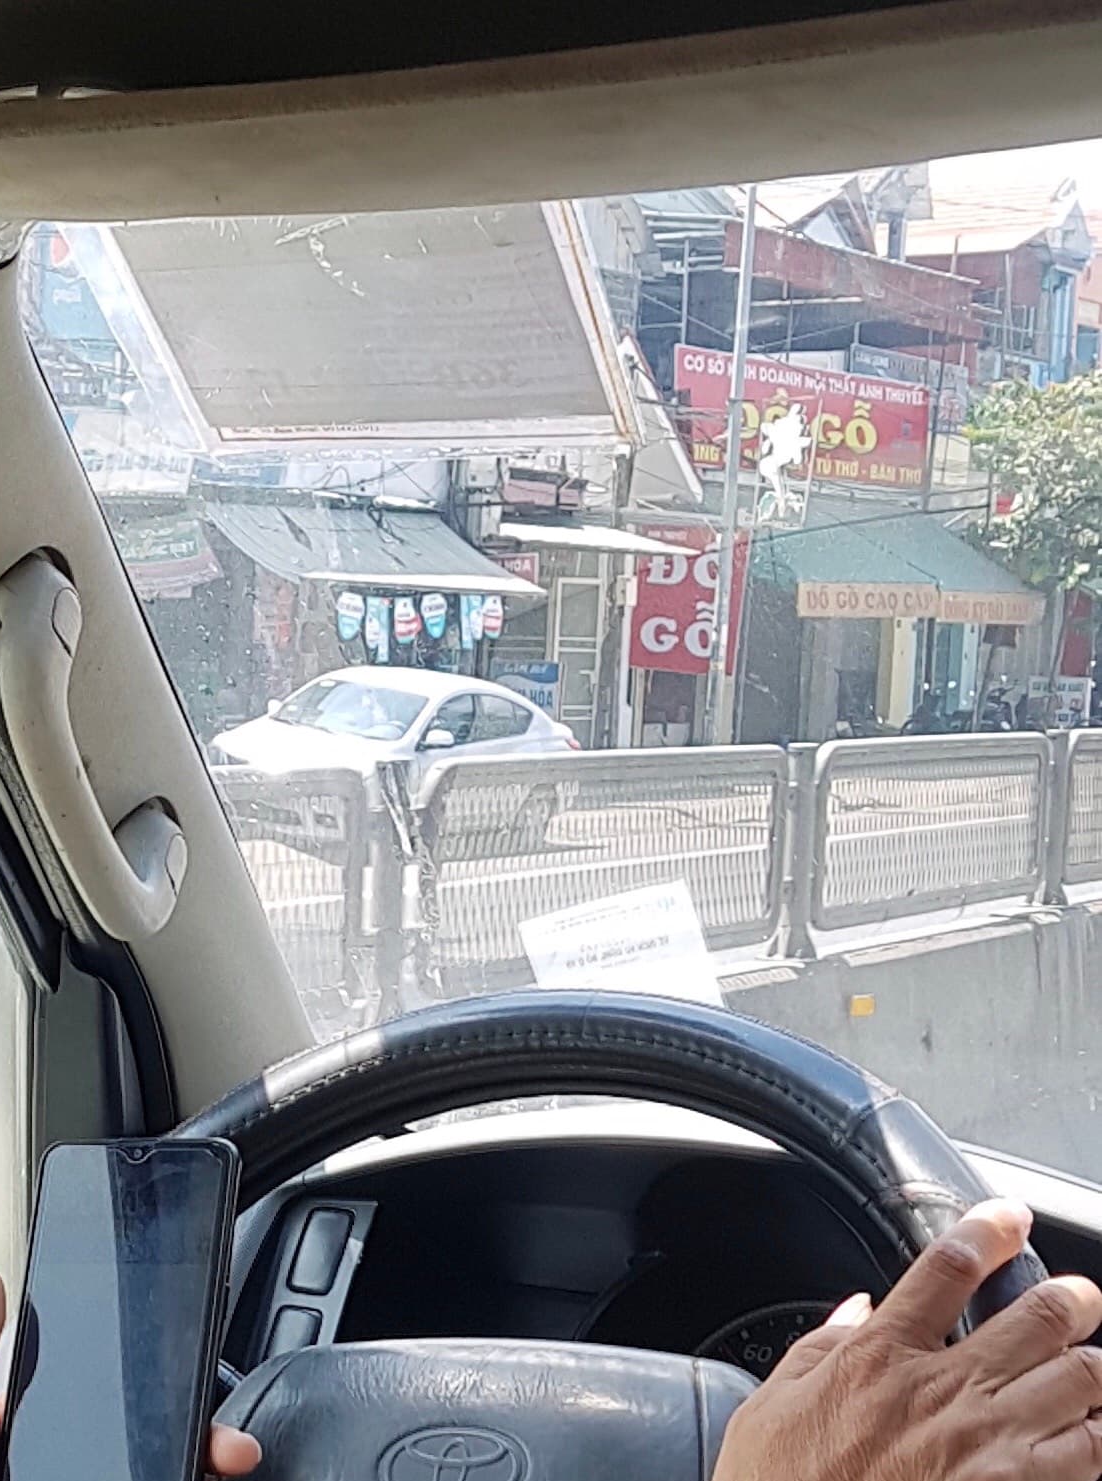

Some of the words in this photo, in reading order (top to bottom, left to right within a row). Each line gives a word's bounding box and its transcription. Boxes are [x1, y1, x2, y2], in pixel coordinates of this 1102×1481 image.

[759, 368, 803, 388] DOANH
[858, 383, 883, 400] ANH
[810, 400, 878, 455] GỖ
[743, 1343, 773, 1363] 60
